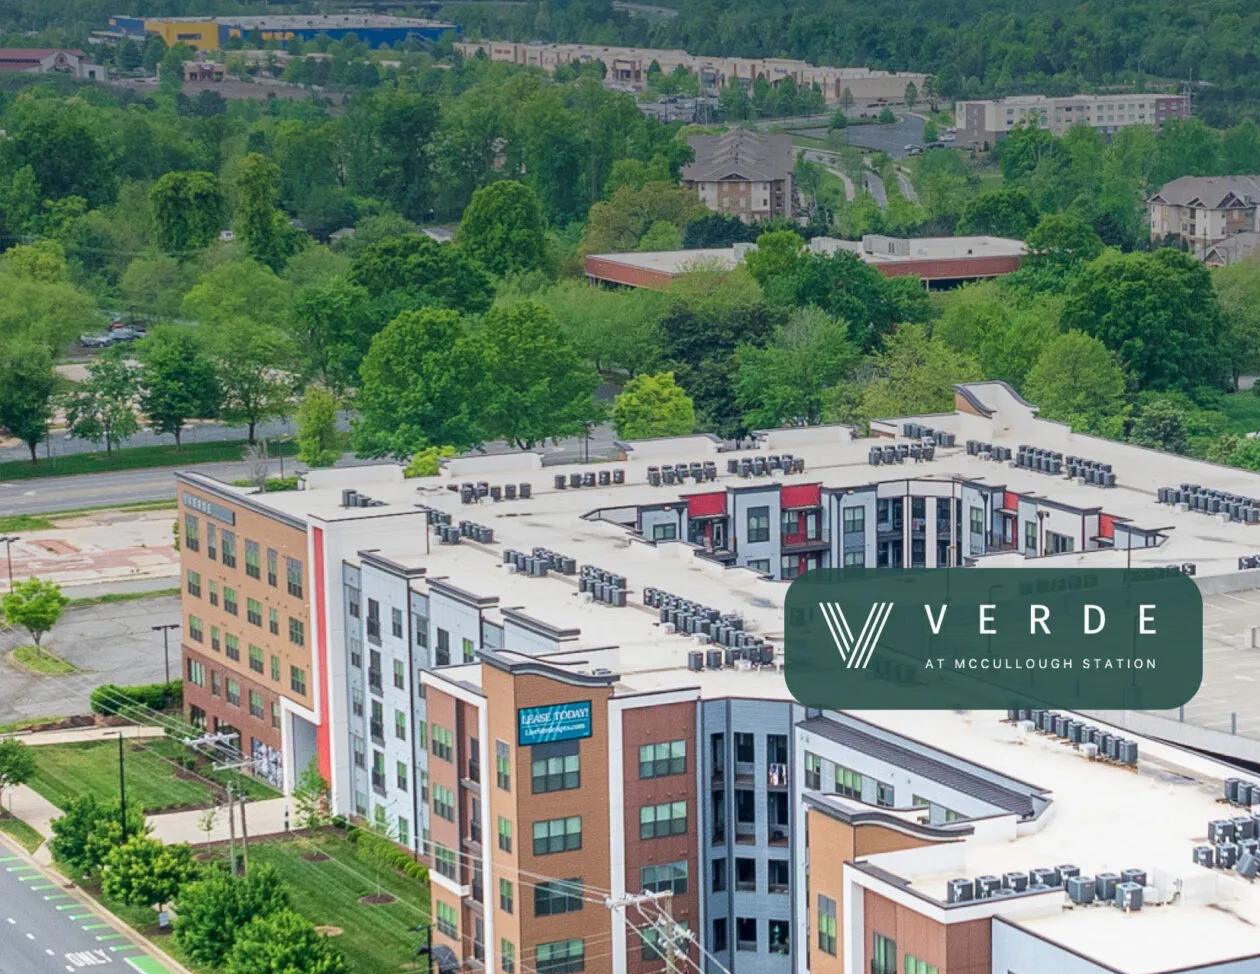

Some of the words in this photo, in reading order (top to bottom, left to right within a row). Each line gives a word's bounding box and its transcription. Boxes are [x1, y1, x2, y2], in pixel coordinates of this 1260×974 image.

[521, 712, 551, 725] LEASE
[554, 707, 589, 721] TODAY!
[64, 949, 113, 967] ONLY
